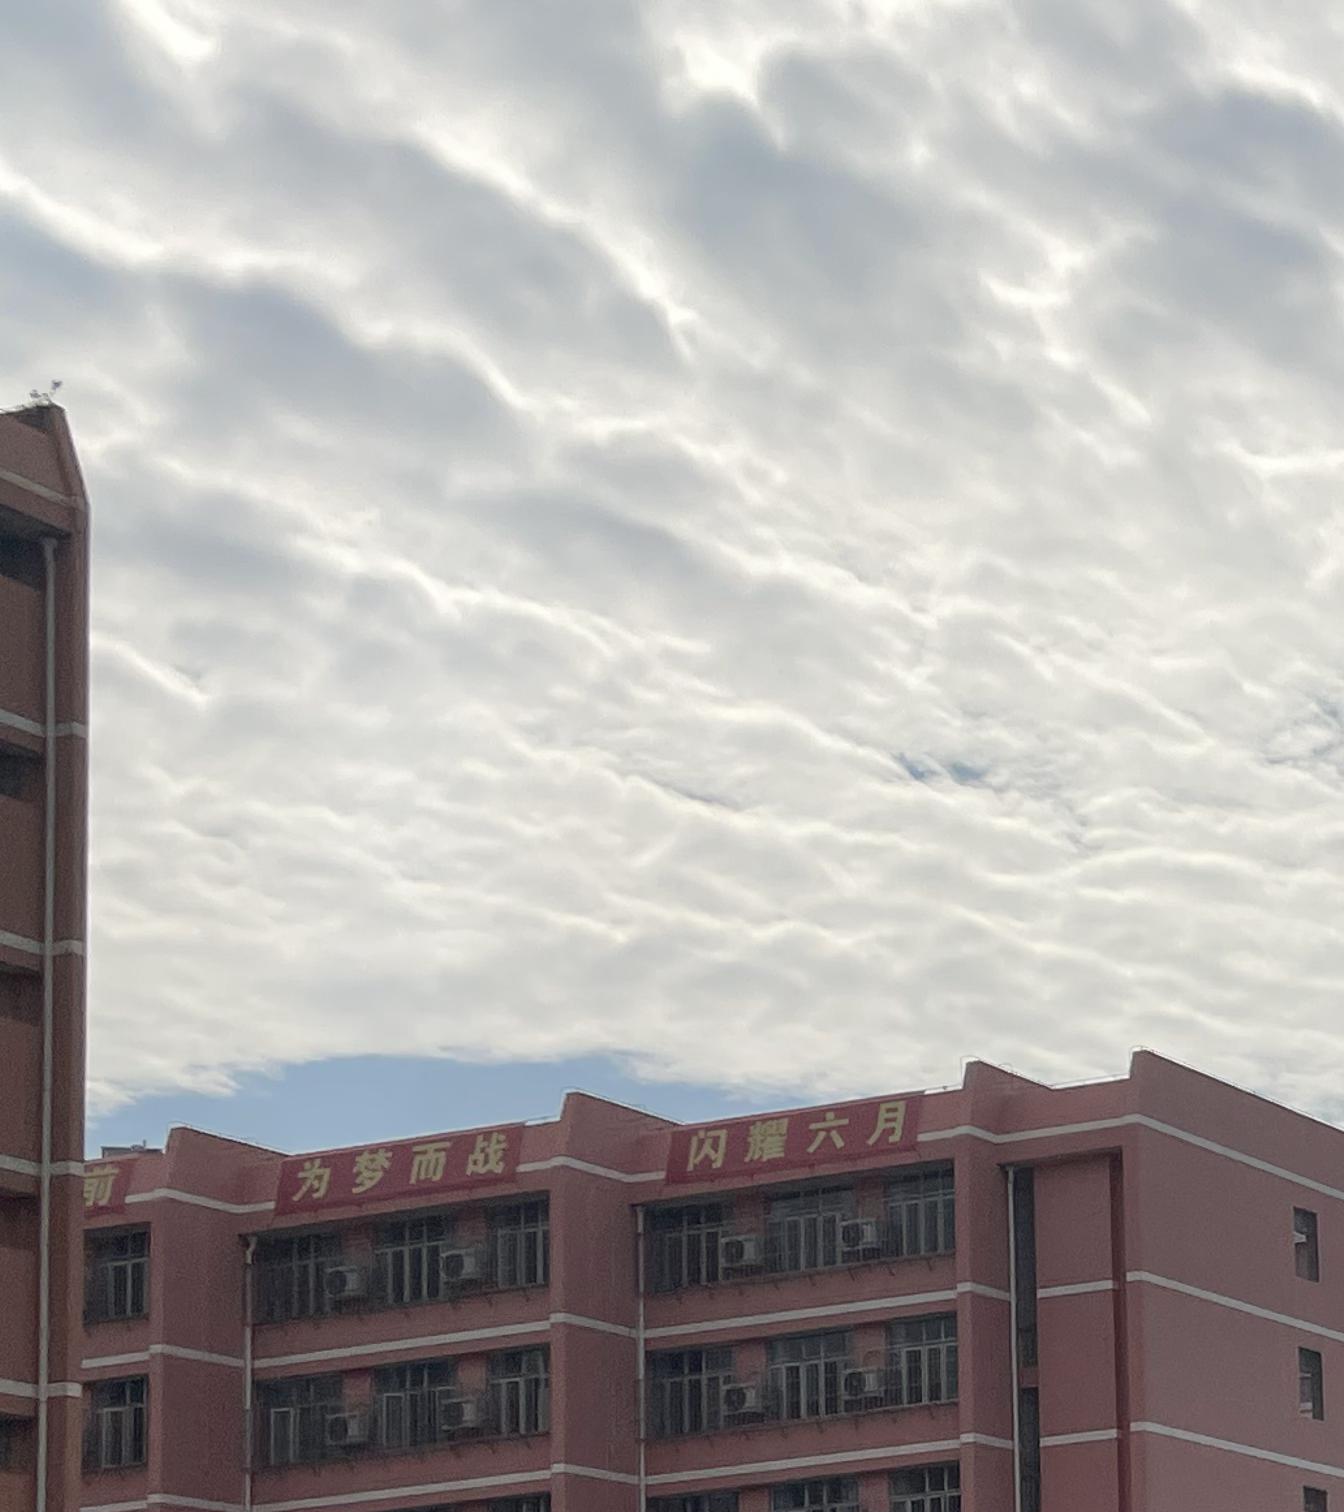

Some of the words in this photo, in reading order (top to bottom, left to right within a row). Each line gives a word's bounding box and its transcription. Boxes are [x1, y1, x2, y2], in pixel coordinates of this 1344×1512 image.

[292, 1132, 507, 1201] 为梦而战
[687, 1100, 906, 1172] 闪耀六月
